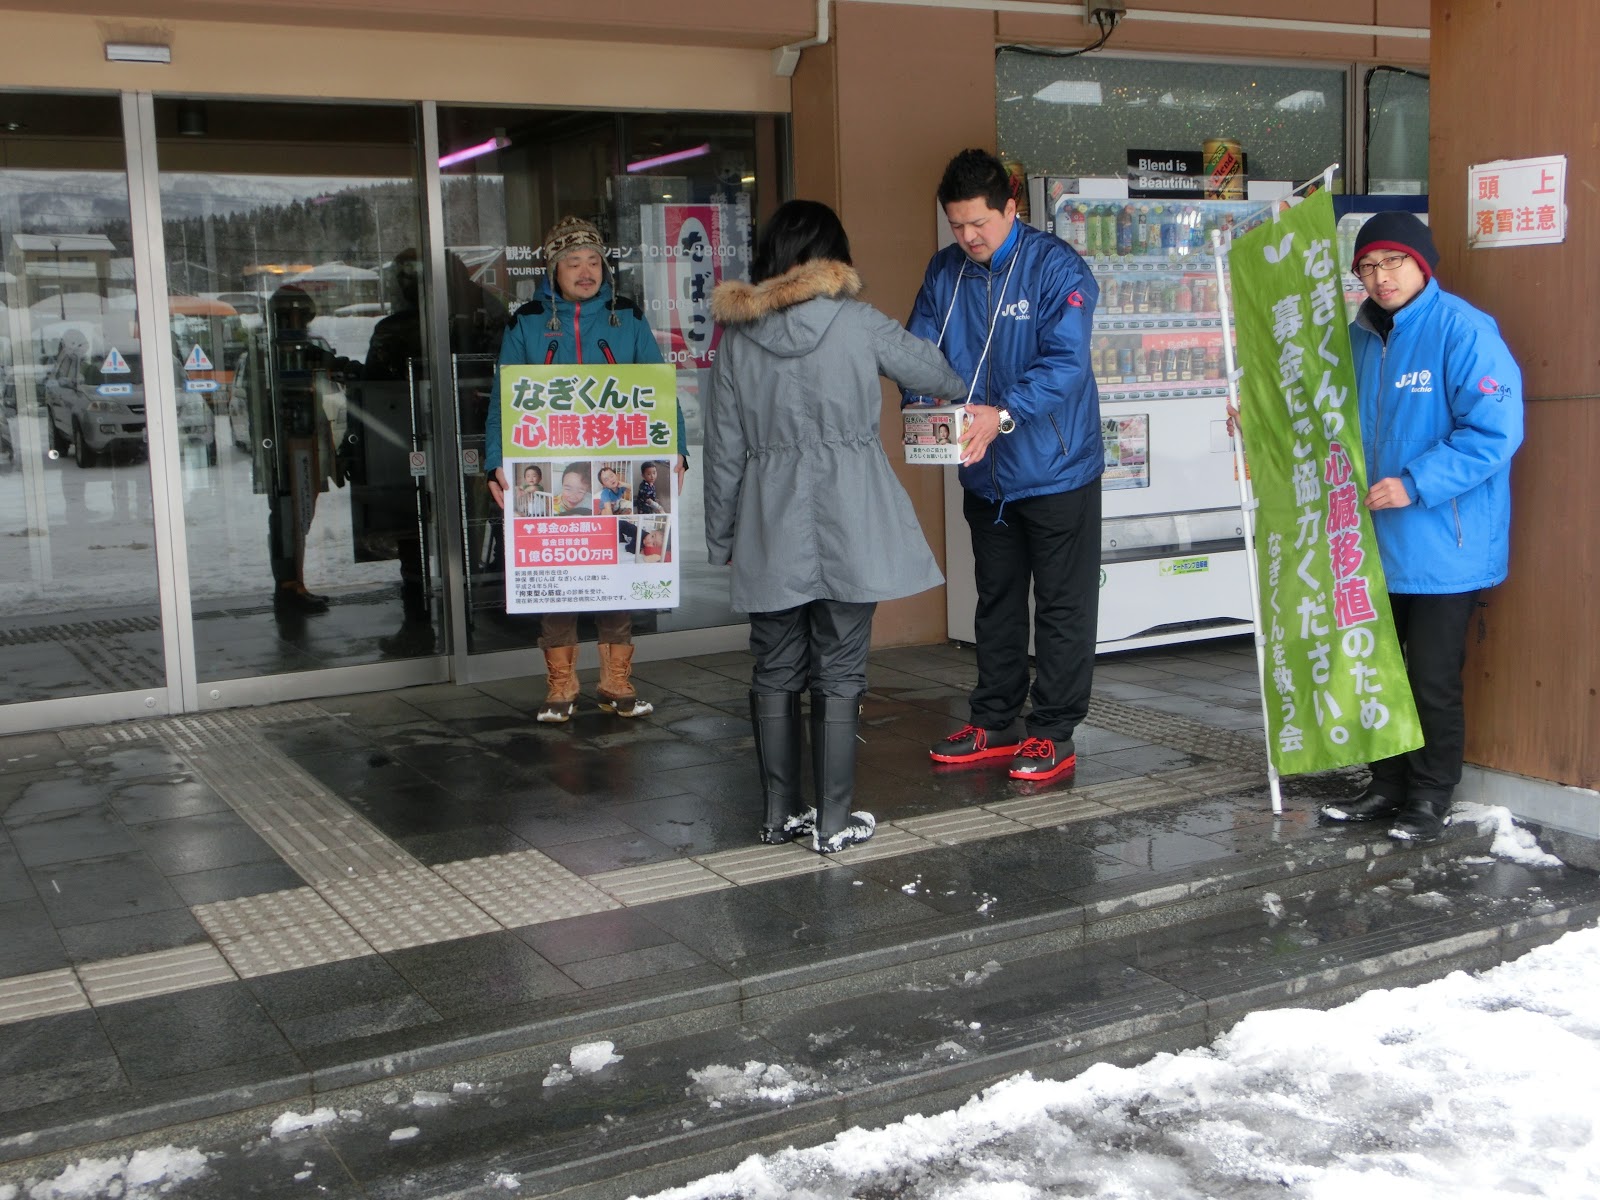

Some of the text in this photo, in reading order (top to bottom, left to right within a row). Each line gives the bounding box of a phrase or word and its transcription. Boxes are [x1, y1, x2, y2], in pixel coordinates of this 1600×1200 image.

[1139, 159, 1187, 171] Blend is
[1139, 176, 1198, 189] Beautiful.
[1476, 204, 1556, 235] 落雪注意
[506, 246, 547, 260] 観光イ
[506, 267, 547, 275] TOURIST
[512, 376, 655, 411] なぎくんに
[512, 414, 671, 448] 心臓移植を
[1303, 239, 1390, 730] なぎくんの心臓移植のため
[536, 521, 602, 534] 募金のお願い
[518, 547, 613, 563] 1億6500万円
[1267, 531, 1304, 753] なぎくんを救う会
